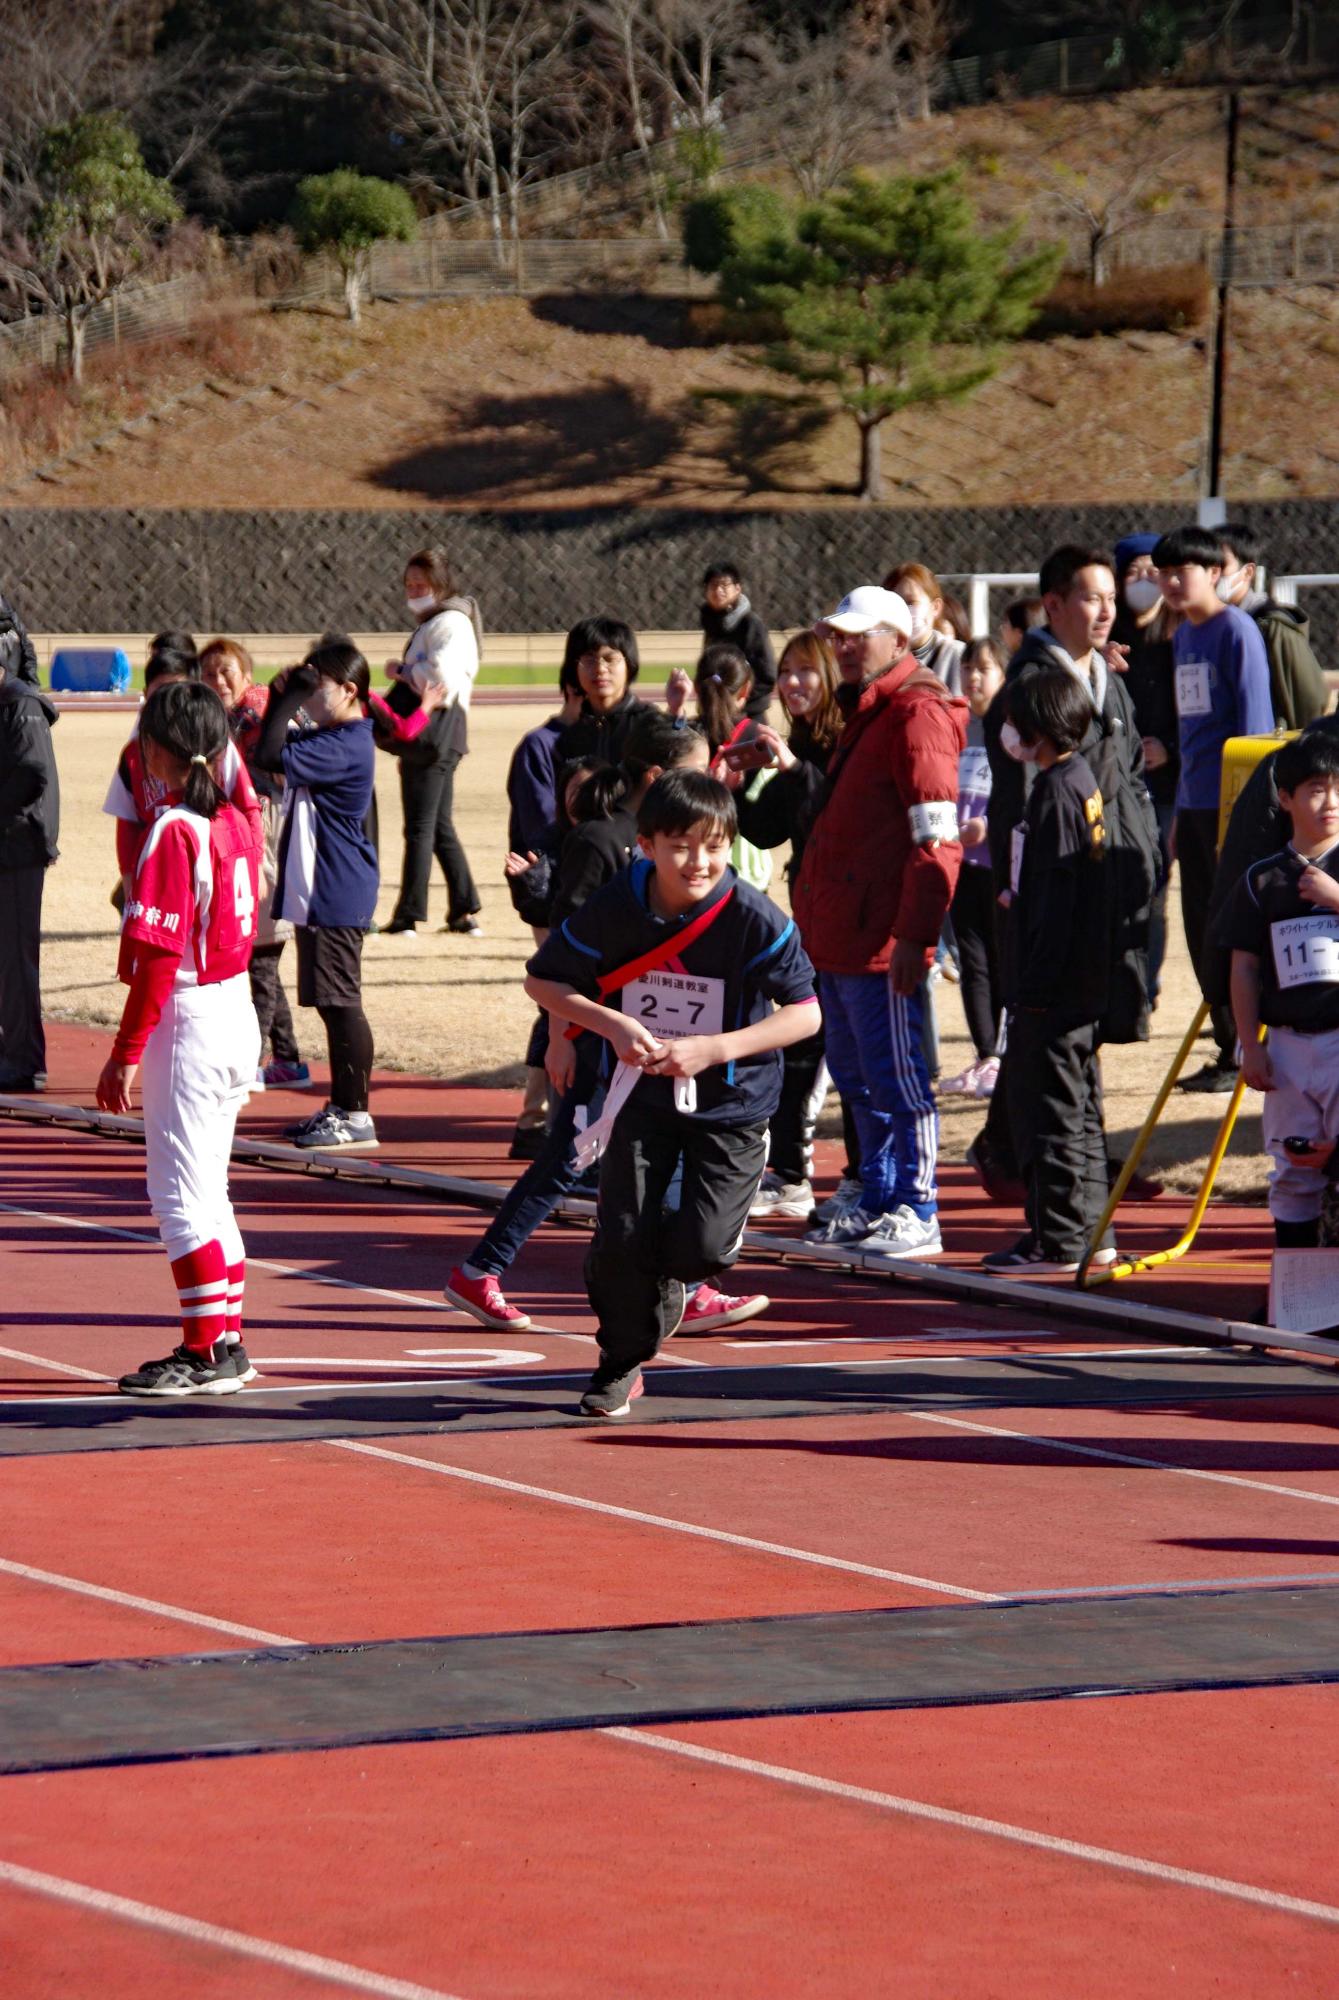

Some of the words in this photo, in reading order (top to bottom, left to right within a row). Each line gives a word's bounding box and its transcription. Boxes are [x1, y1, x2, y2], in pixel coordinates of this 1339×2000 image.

[233, 857, 254, 937] 4
[128, 900, 180, 933] 神奈川
[640, 994, 705, 1025] 2-7
